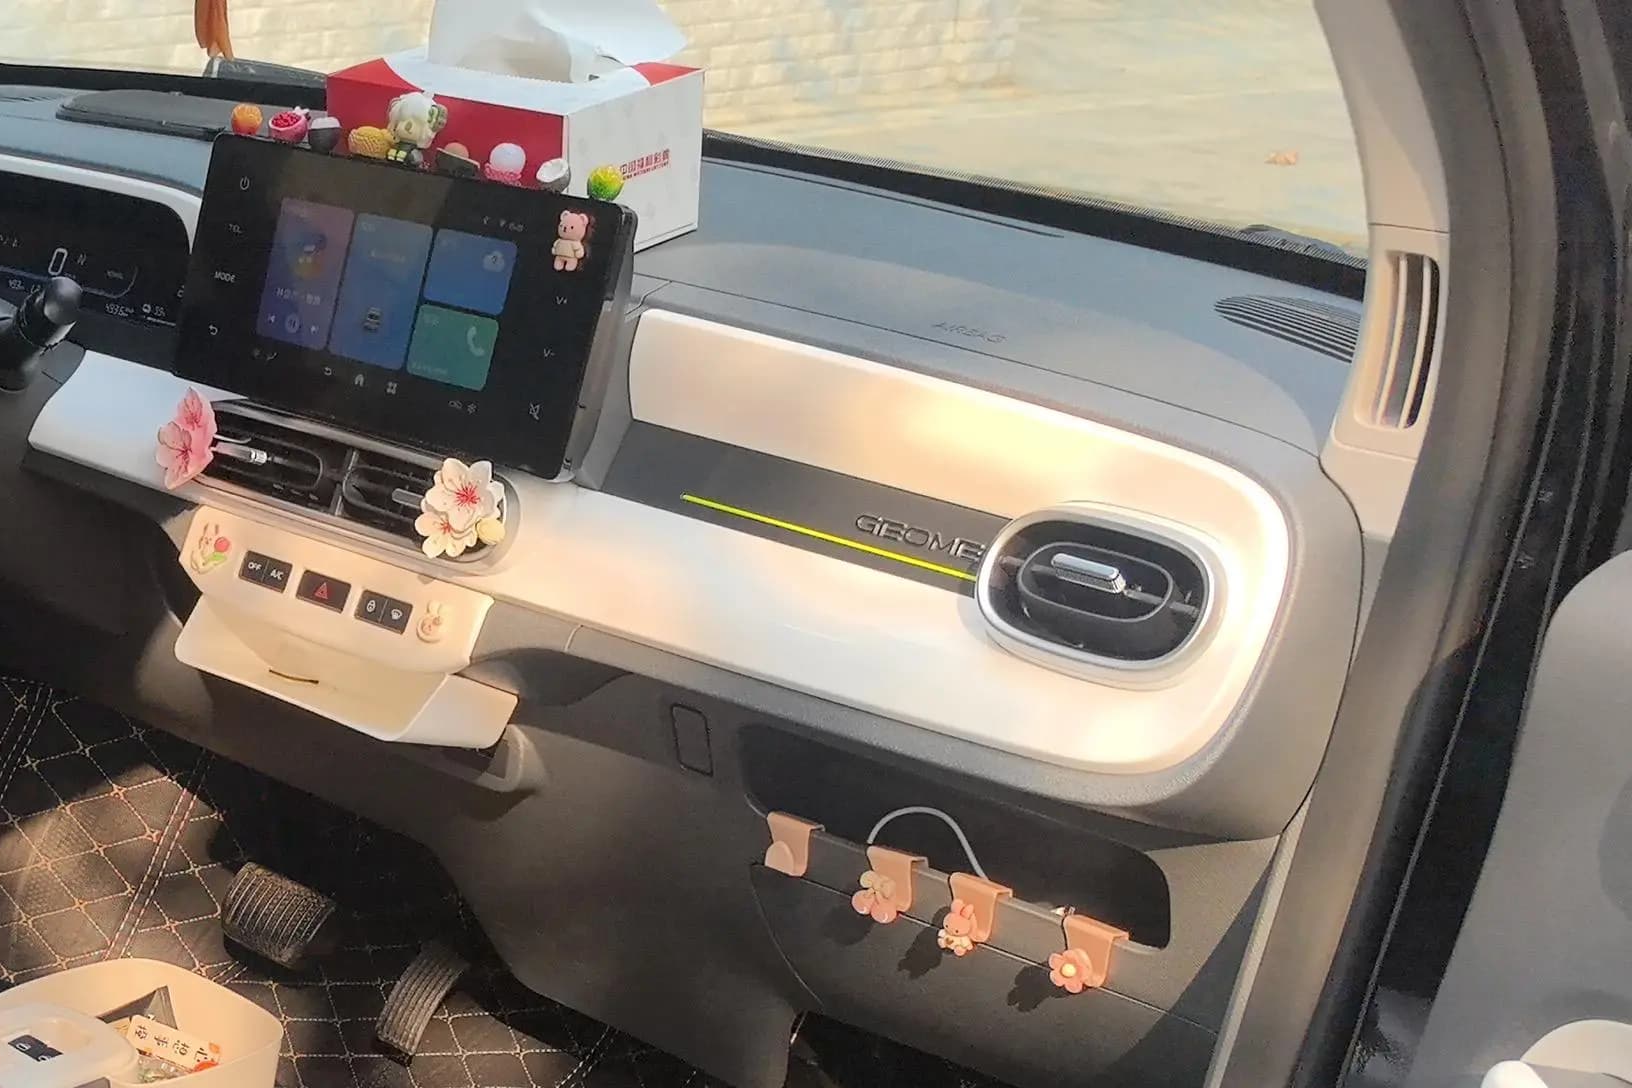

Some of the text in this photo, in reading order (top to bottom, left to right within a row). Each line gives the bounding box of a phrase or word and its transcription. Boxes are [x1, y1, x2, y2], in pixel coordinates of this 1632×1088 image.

[48, 248, 68, 276] 0
[214, 270, 237, 284] MODE
[855, 513, 987, 561] GEOME
[247, 561, 262, 571] OFF
[270, 568, 284, 581] A/C
